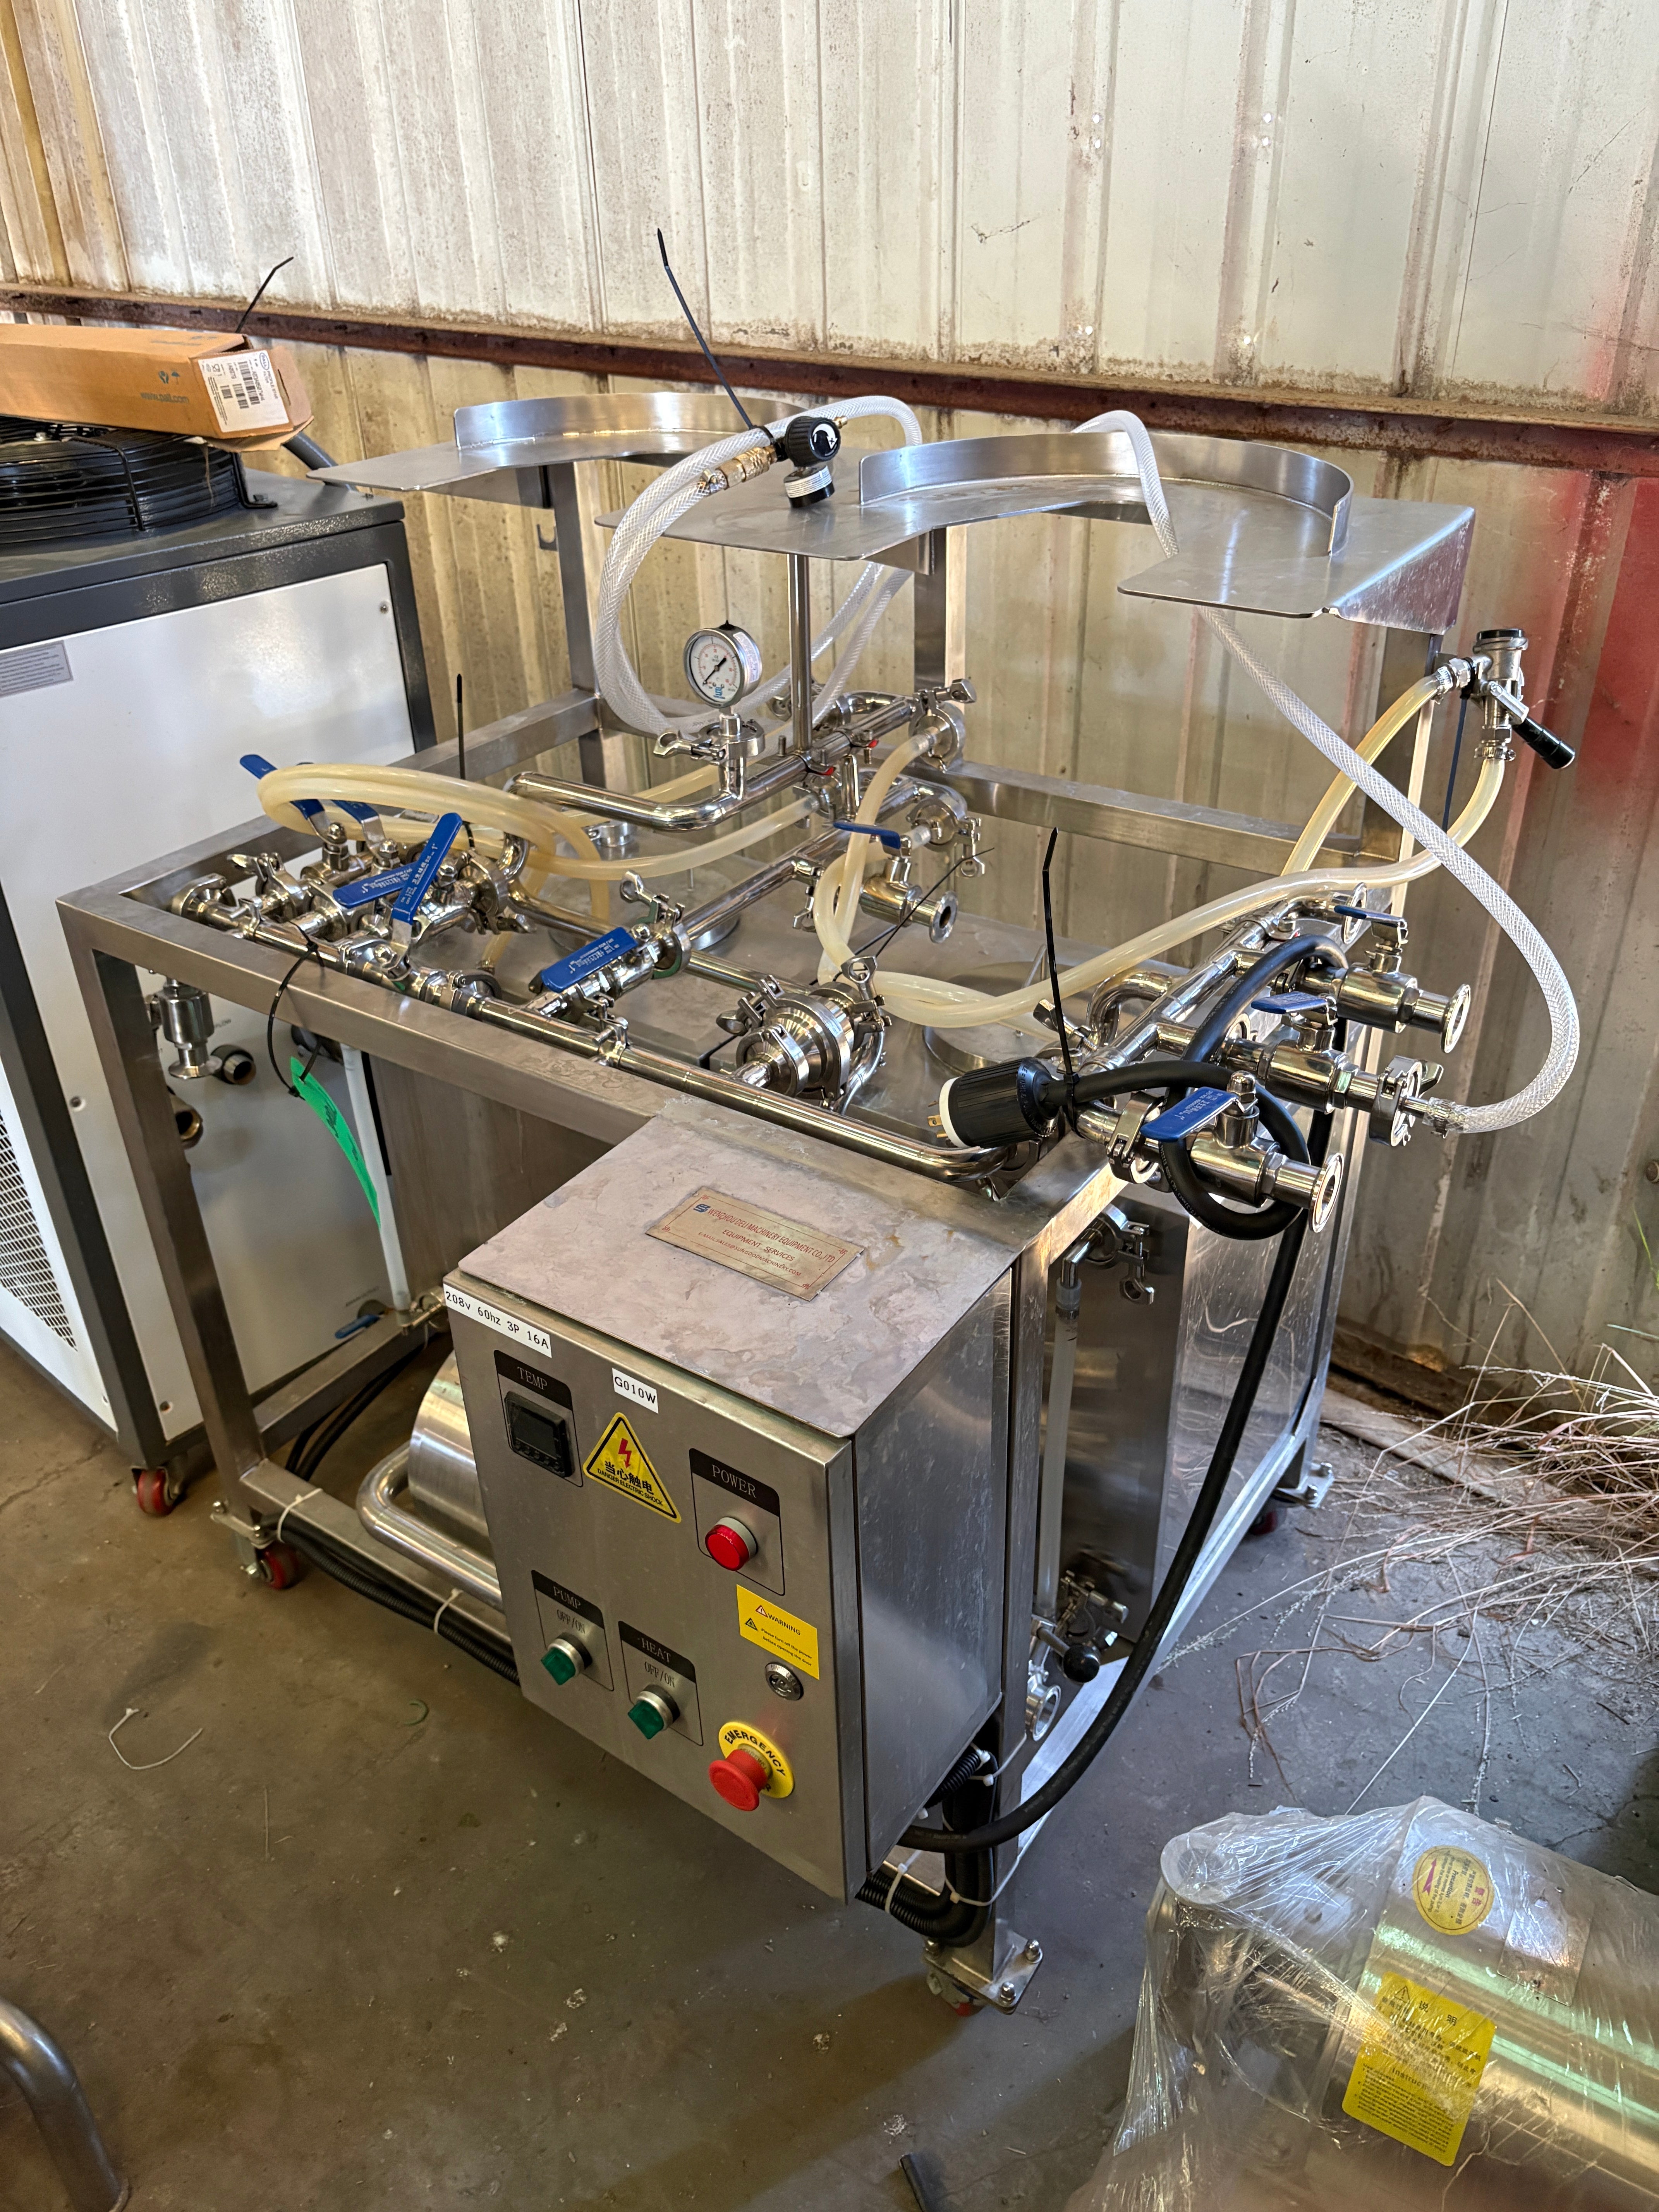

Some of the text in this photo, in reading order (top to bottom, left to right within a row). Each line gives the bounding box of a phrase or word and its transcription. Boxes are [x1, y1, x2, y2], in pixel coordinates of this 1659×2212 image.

[708, 1208, 735, 1223] WENZHOU
[734, 1219, 749, 1228] DELI
[746, 1223, 781, 1241] MACHINERY
[778, 1236, 814, 1254] EQUIPMENT
[722, 1229, 795, 1261] EQUIPMENT SERVICES
[446, 1291, 549, 1349] 208v 60hz 3P 16A
[517, 1366, 547, 1390] TEMP
[614, 1376, 656, 1404] G010W
[598, 1468, 663, 1506] DANGER ELECTRIC SHOCK
[605, 1460, 654, 1495] 当心触电
[712, 1464, 756, 1498] POWER
[553, 1586, 581, 1609] PUMP
[768, 1613, 801, 1635] WARNING
[641, 1638, 671, 1663] HEAT
[761, 1628, 774, 1638] Please
[799, 1650, 812, 1659] power
[763, 1635, 776, 1646] before
[777, 1645, 793, 1657] opening
[724, 1730, 786, 1776] EMERGENCY
